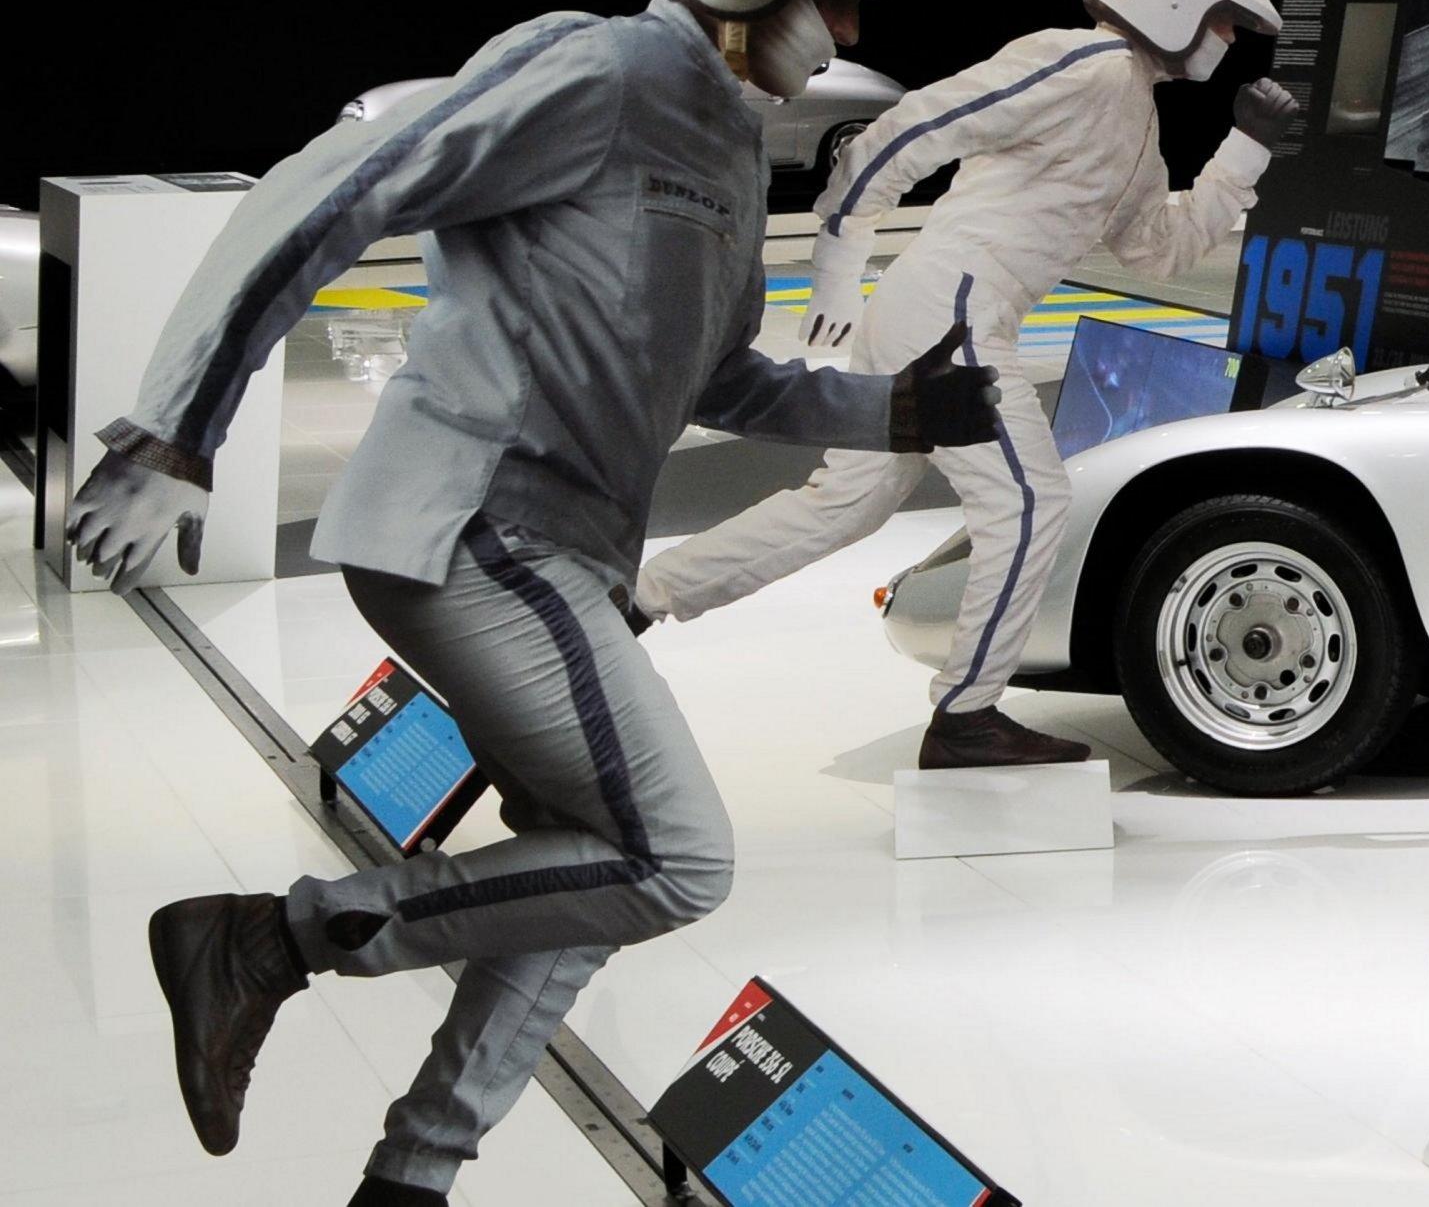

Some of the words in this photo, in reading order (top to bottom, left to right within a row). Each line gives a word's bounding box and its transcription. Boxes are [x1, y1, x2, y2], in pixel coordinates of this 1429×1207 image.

[1238, 234, 1386, 374] 1951
[731, 1025, 773, 1065] PORSCHE
[705, 1050, 746, 1083] COUPÉ
